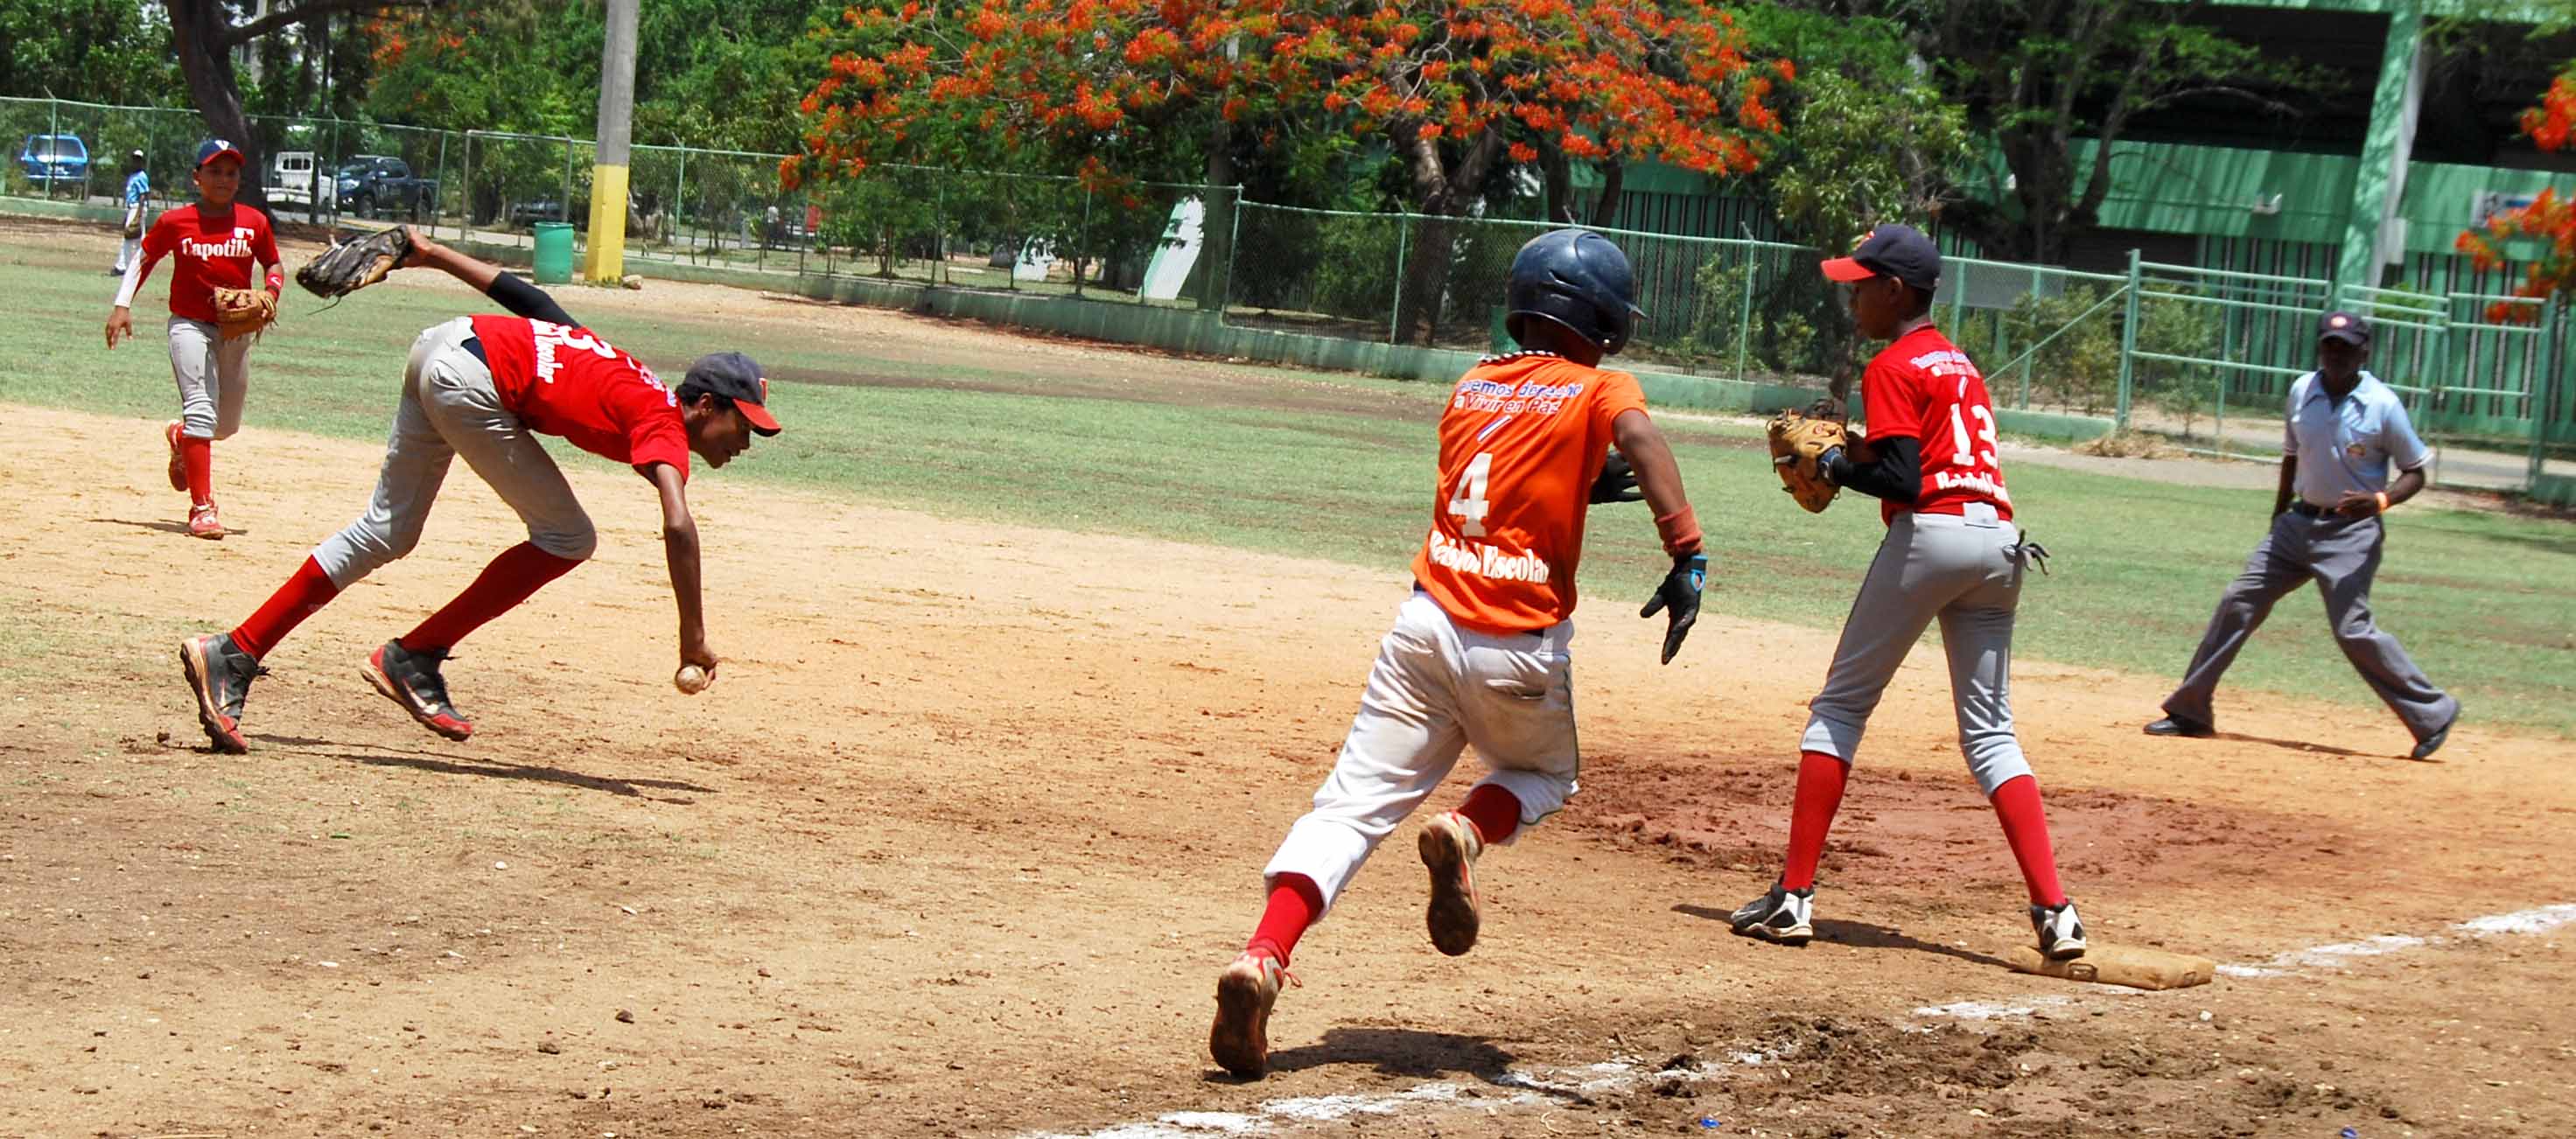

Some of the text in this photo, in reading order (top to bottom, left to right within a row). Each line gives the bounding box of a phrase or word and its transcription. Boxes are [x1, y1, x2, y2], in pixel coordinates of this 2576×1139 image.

[1466, 393, 1505, 413] Vivir
[1504, 400, 1526, 414] en
[1526, 398, 1562, 415] Paz
[1950, 402, 1999, 470] 13
[1447, 451, 1494, 537] 4
